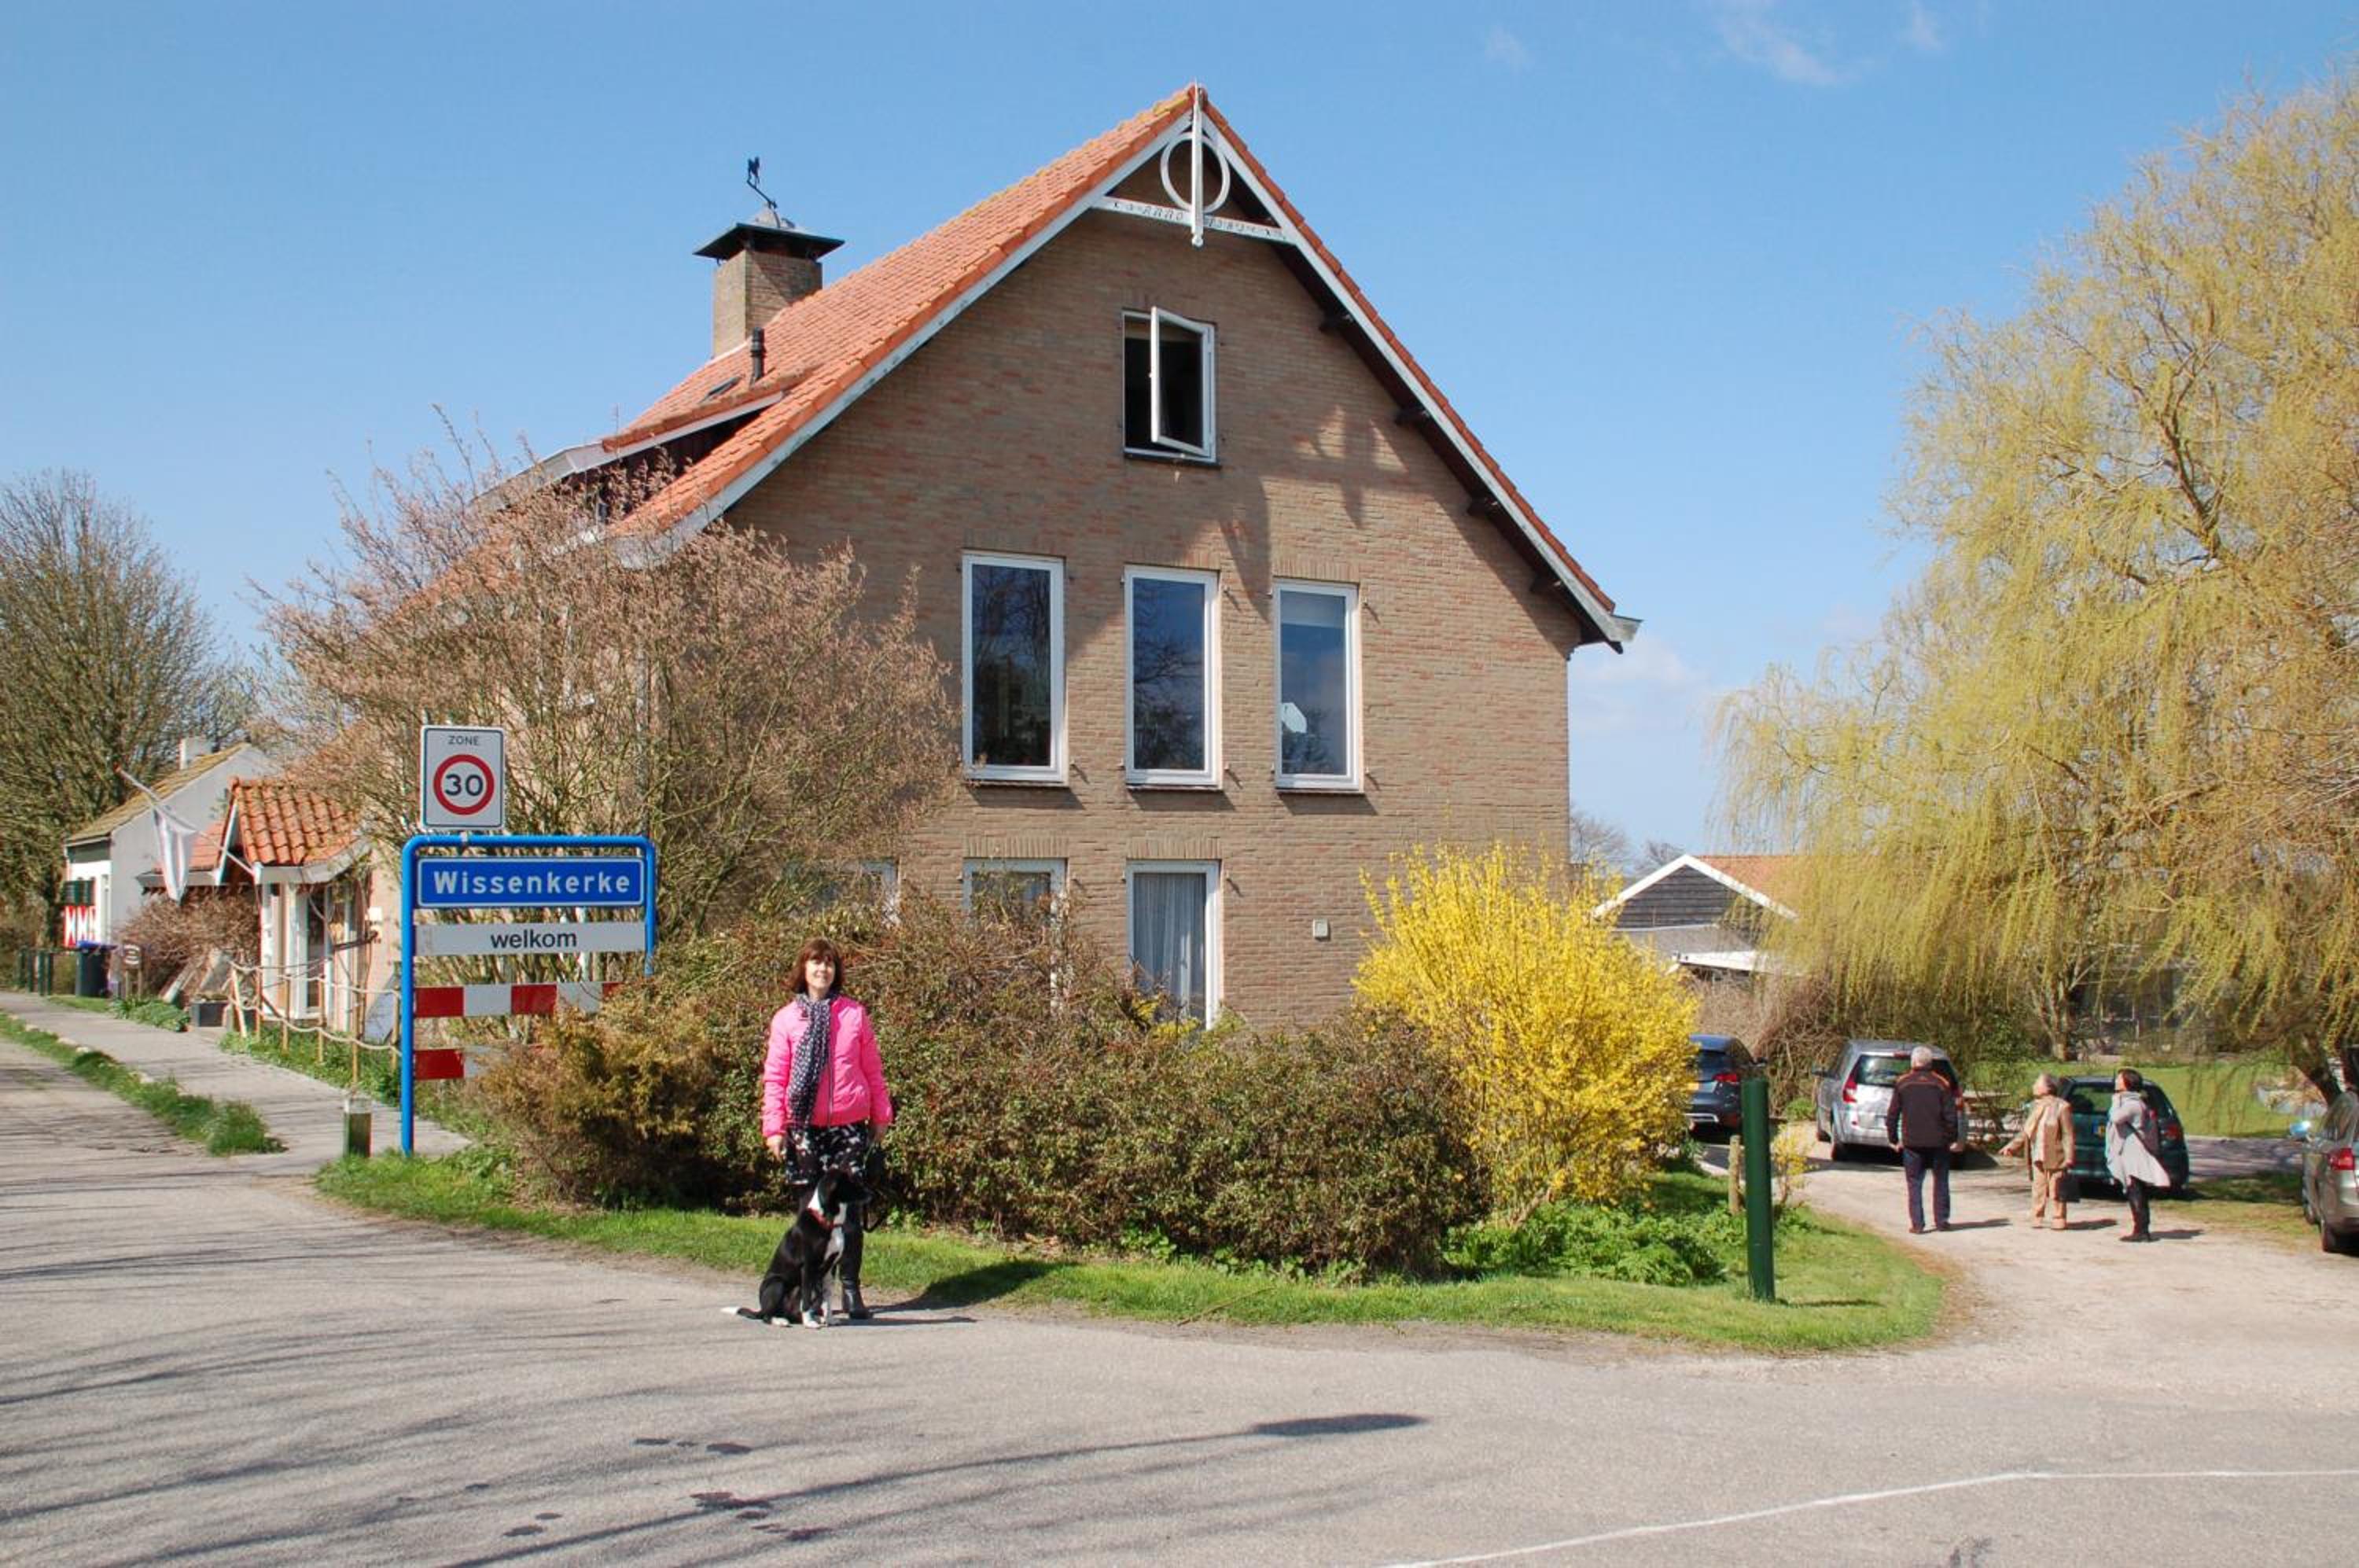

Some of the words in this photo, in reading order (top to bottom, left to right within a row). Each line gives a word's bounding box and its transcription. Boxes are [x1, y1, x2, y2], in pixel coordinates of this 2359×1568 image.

[448, 735, 479, 745] ZONE
[445, 774, 484, 796] 30
[434, 870, 630, 894] Wissenkerke
[491, 929, 577, 948] welkom
